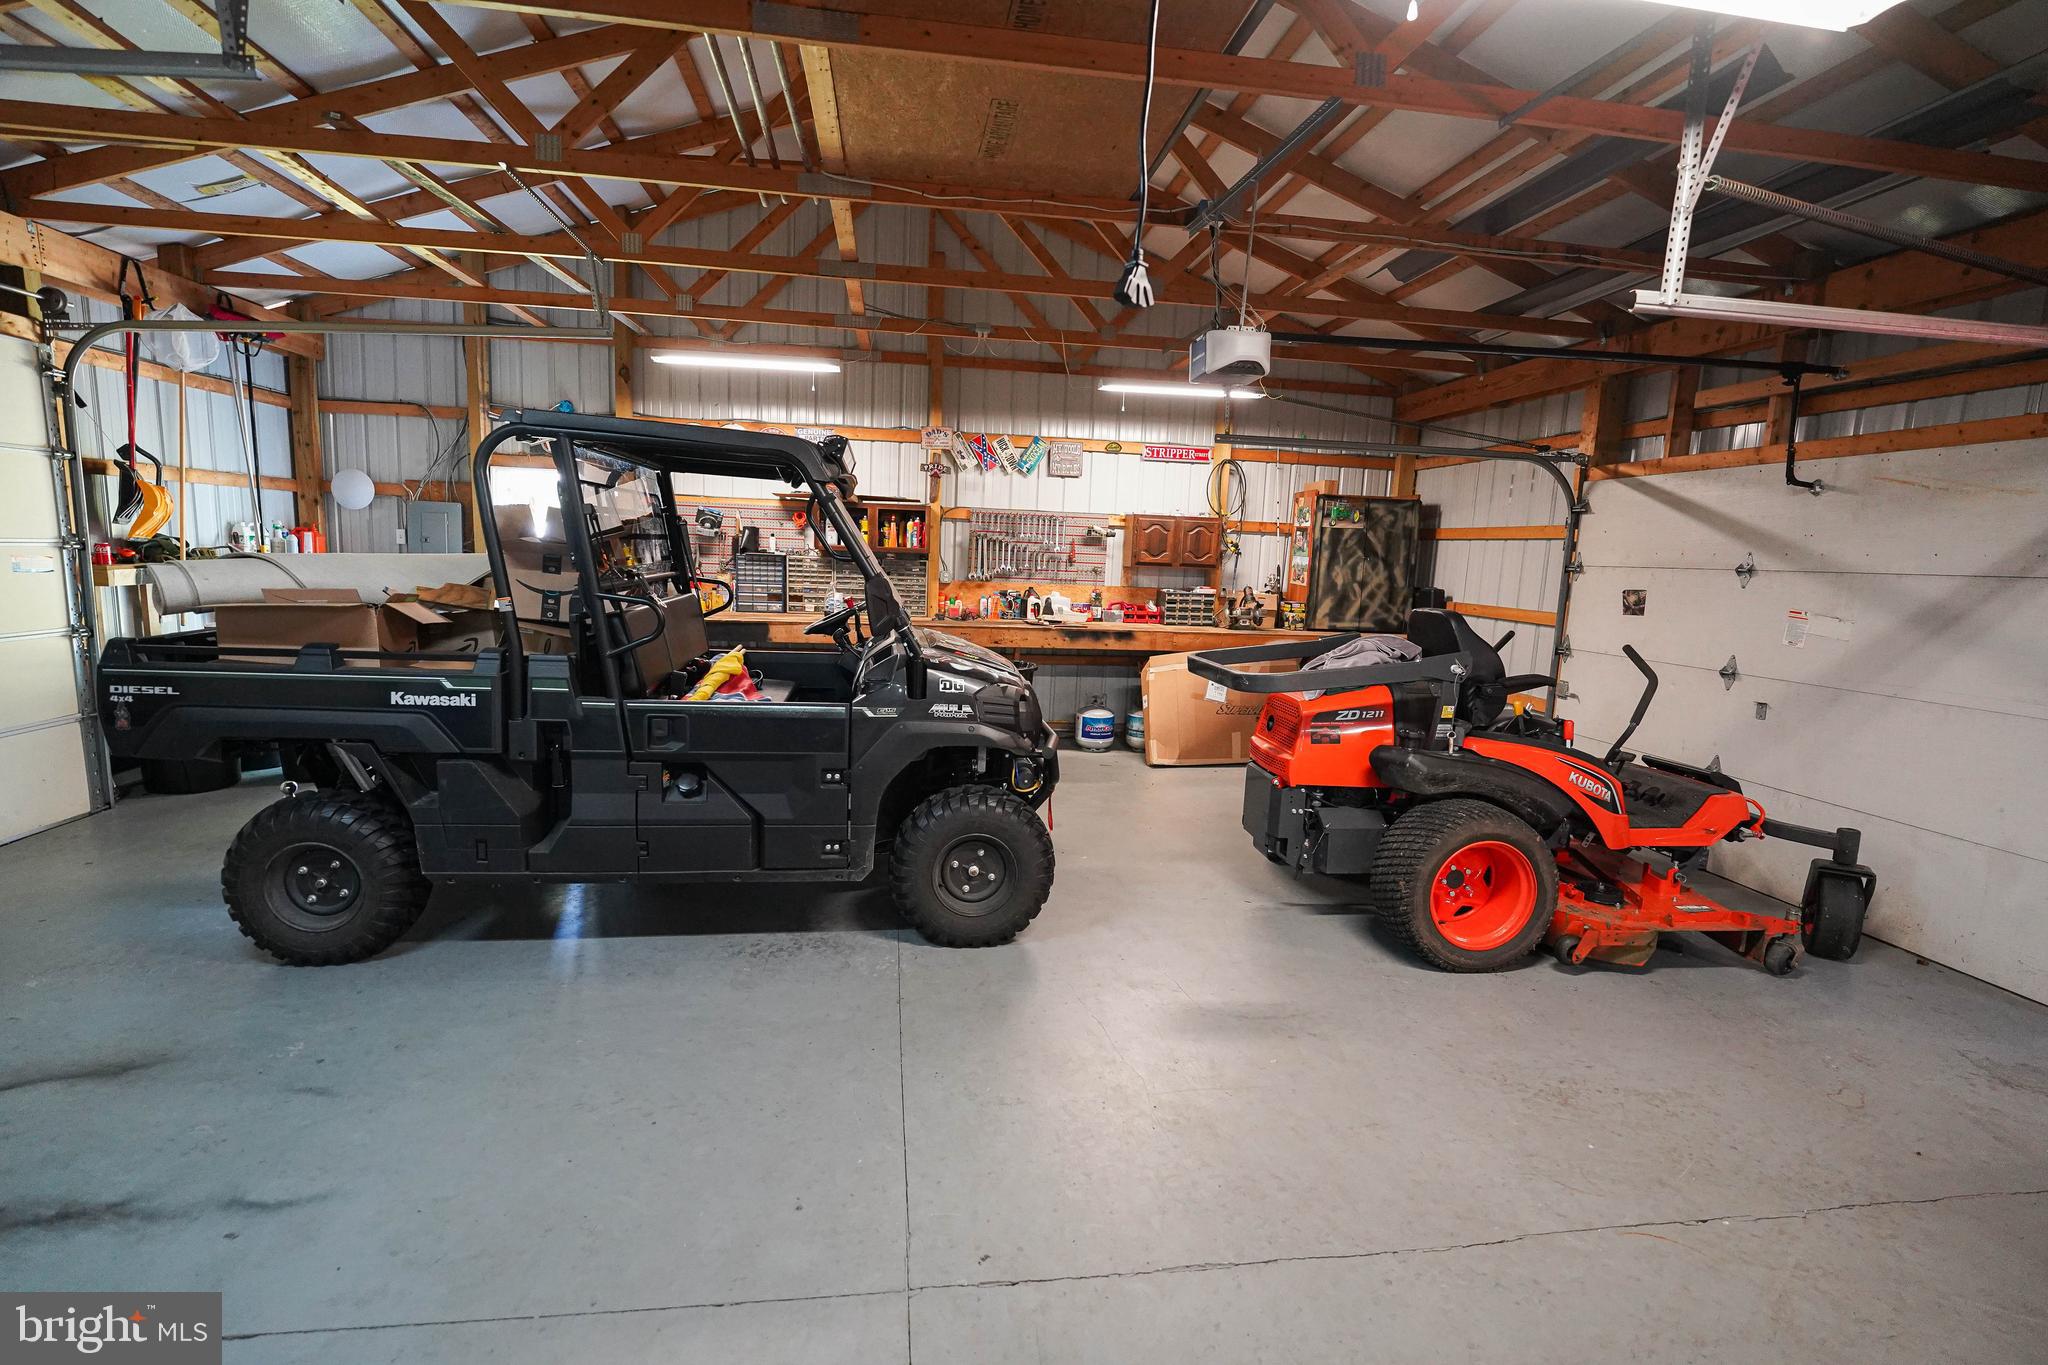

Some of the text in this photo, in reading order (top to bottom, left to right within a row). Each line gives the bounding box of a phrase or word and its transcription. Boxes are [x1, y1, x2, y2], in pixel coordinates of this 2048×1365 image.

[797, 428, 832, 436] GENUINE
[1145, 446, 1195, 459] STRIPPER
[109, 685, 180, 695] DIESEL
[390, 691, 477, 707] Kawasaki
[1335, 710, 1385, 720] ZD 1211
[1568, 771, 1612, 802] KUBOTA
